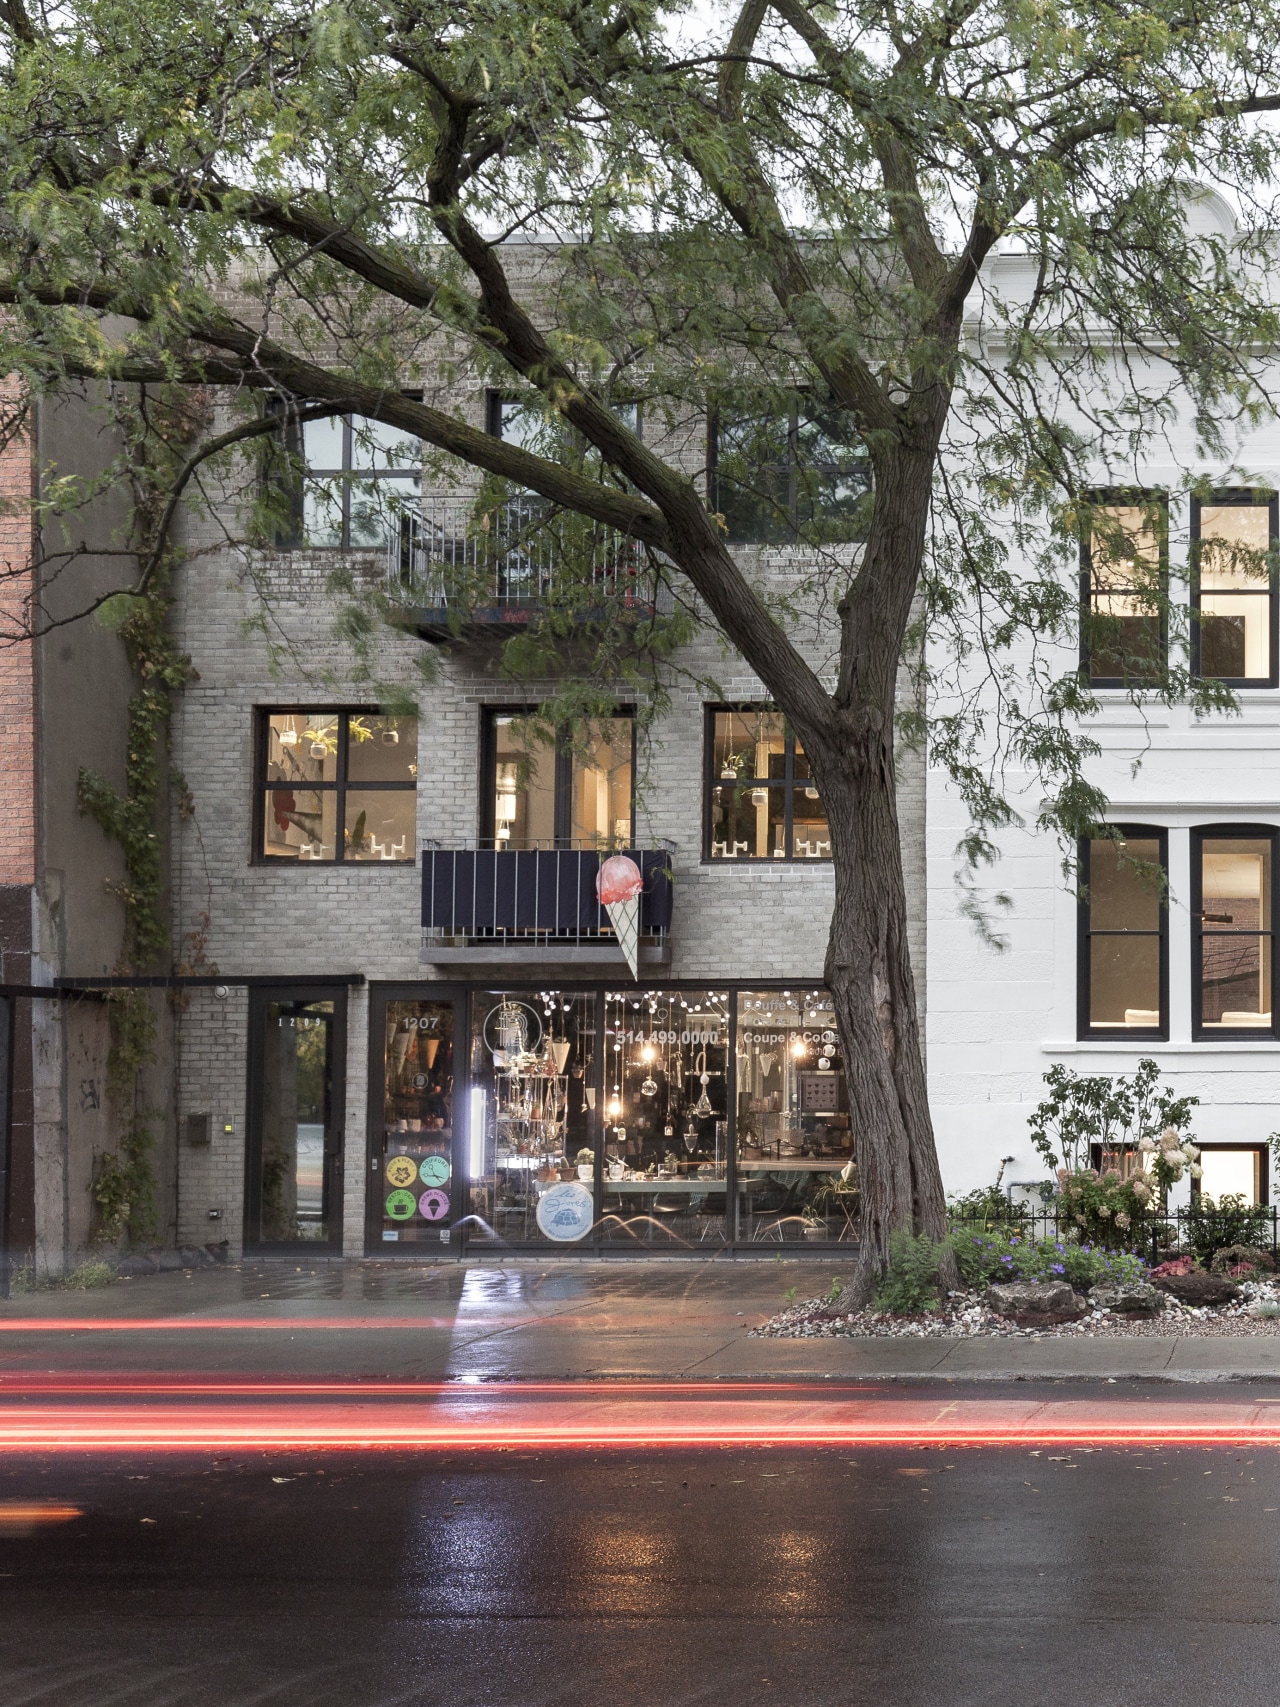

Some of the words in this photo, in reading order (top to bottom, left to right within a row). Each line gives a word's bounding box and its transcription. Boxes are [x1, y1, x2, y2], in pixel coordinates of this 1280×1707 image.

[789, 1000, 800, 1011] &
[803, 999, 834, 1011] Café
[278, 1017, 321, 1027] 1209
[403, 1017, 439, 1029] 1207
[616, 1030, 719, 1045] 514.499.0000
[743, 1031, 786, 1046] Coupe
[789, 1031, 800, 1043] &
[422, 1157, 448, 1169] COIFFURE
